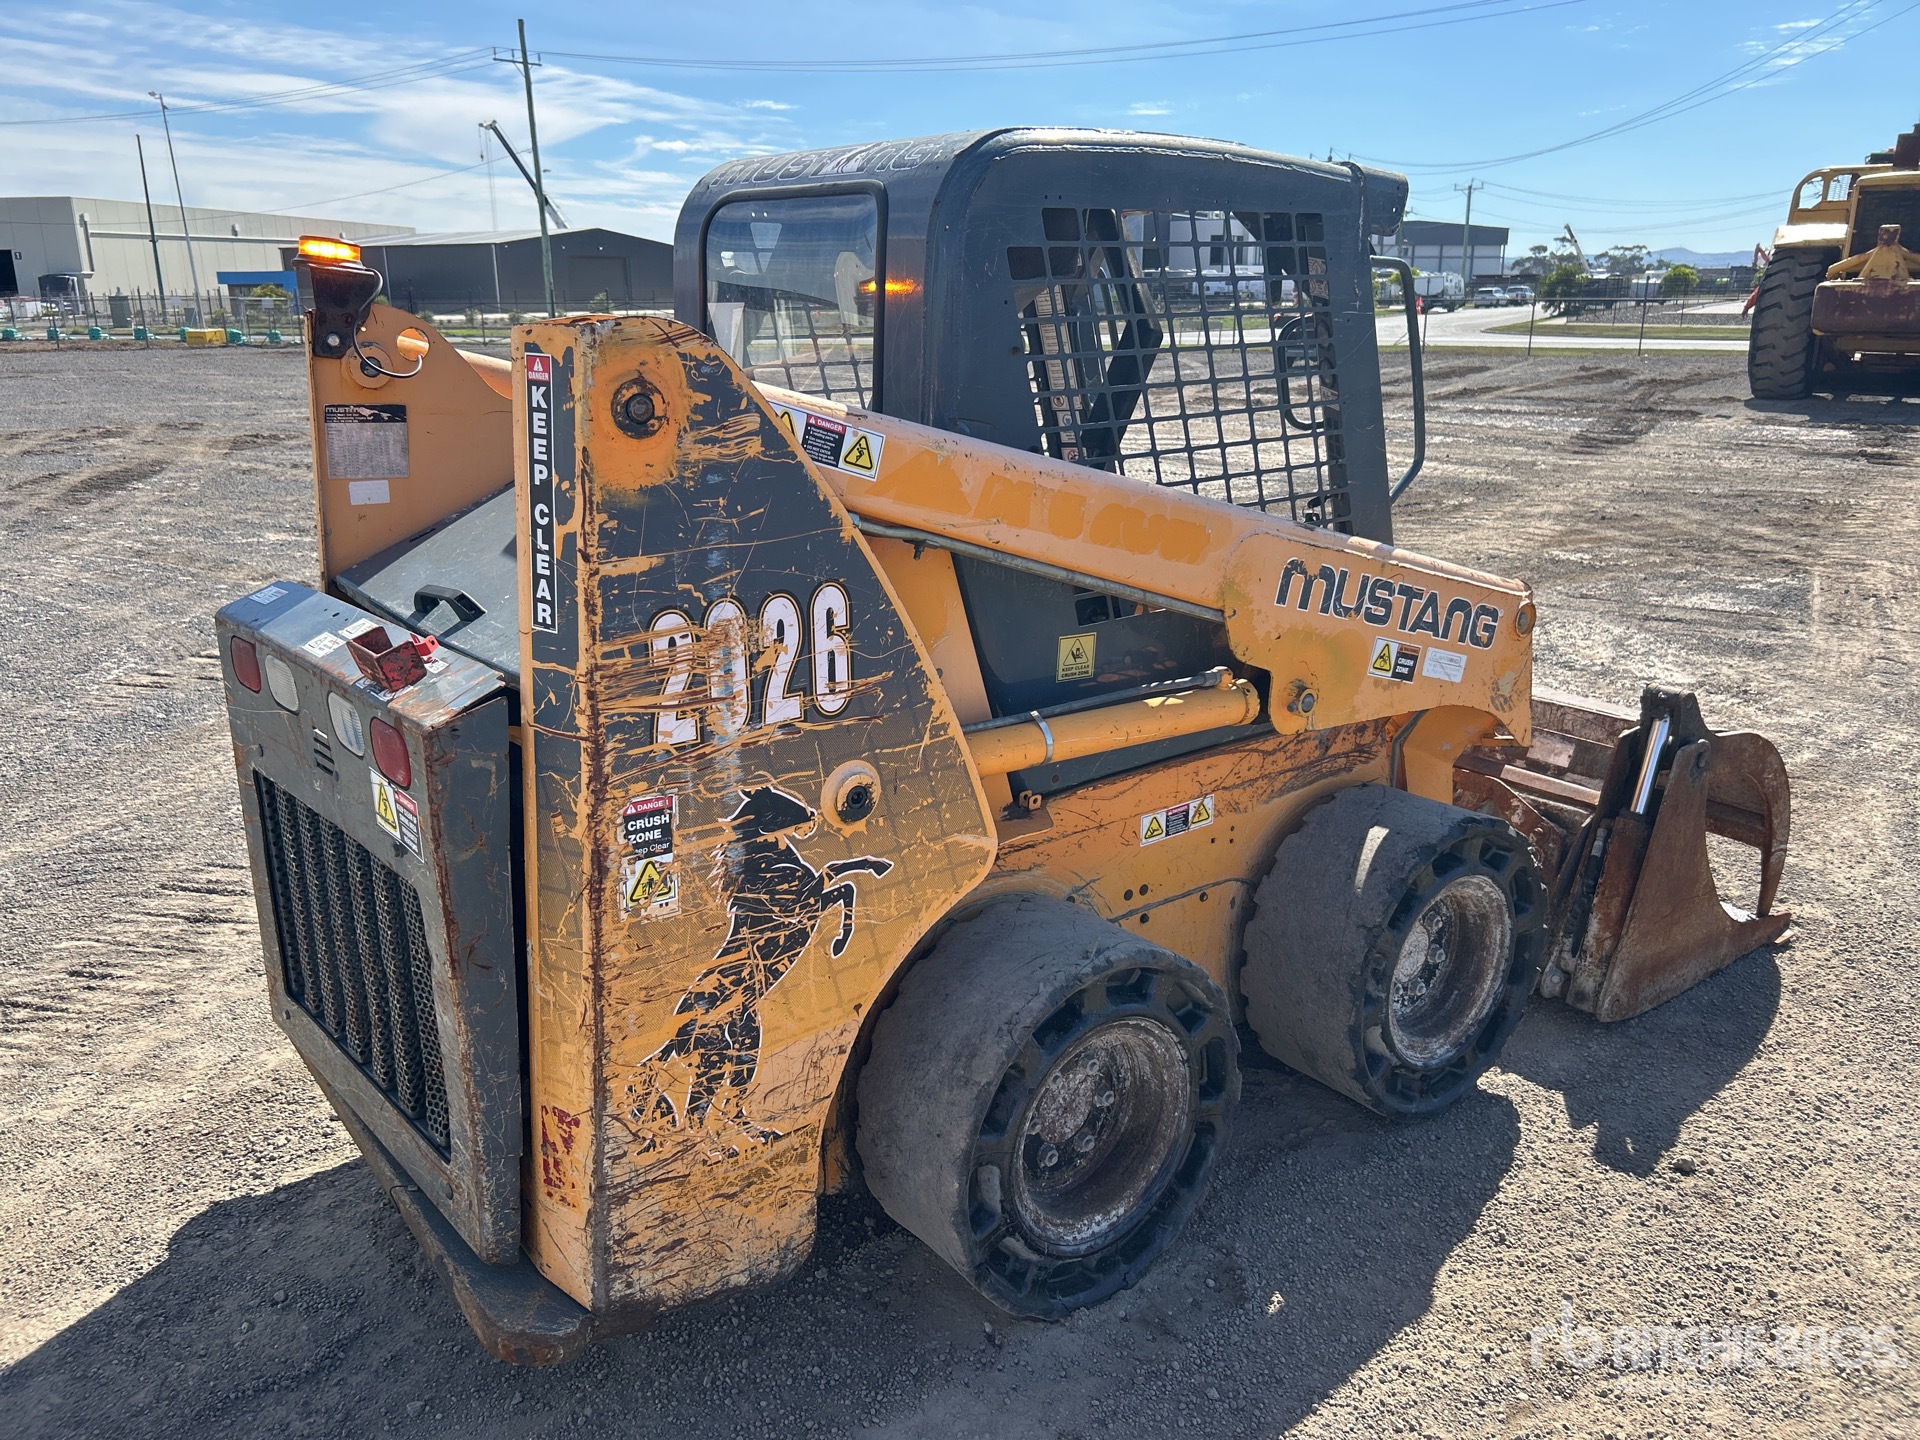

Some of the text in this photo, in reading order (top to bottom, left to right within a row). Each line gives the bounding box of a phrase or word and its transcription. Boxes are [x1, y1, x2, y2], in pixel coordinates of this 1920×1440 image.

[528, 371, 549, 380] DANGER
[817, 420, 842, 432] DANGER
[531, 385, 549, 485] KEEP
[534, 503, 552, 625] CLEAR
[1274, 556, 1501, 650] MUSTANG
[649, 581, 851, 745] 2026
[1398, 657, 1414, 667] CRUSH
[1396, 666, 1409, 675] ZONE
[627, 814, 670, 831] CRUSH
[628, 829, 662, 844] ZONE
[649, 842, 670, 852] Clear
